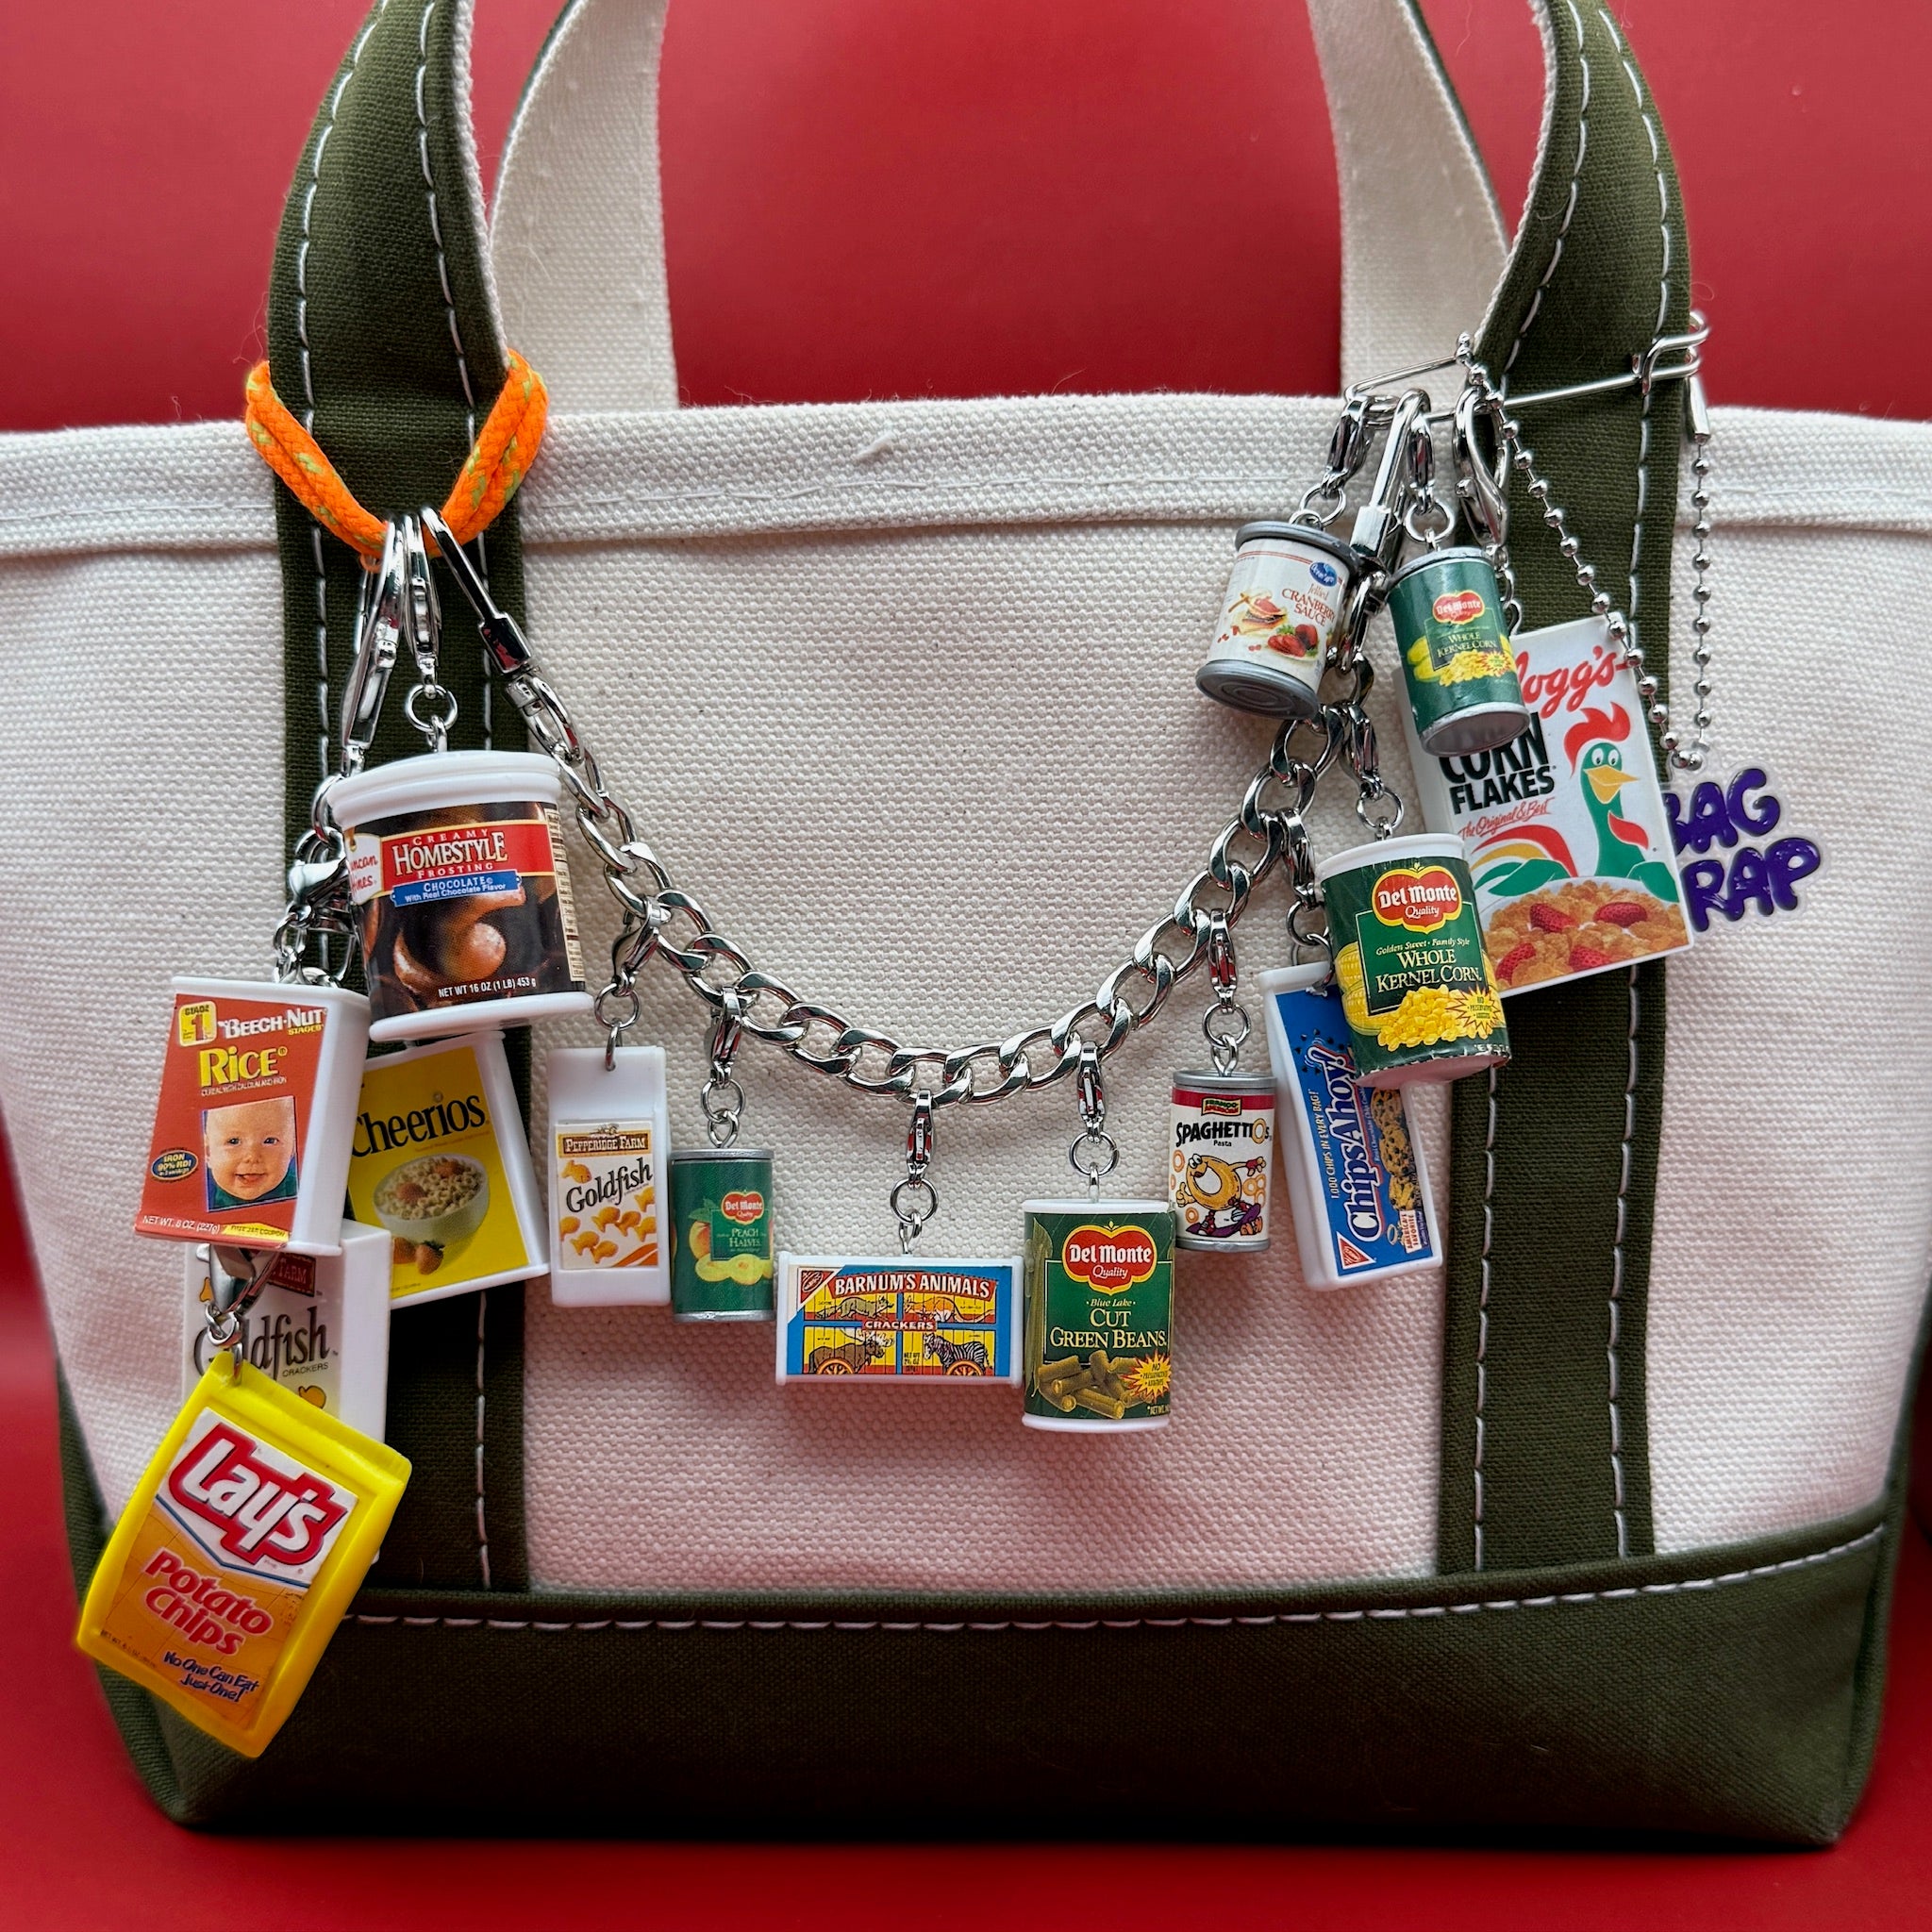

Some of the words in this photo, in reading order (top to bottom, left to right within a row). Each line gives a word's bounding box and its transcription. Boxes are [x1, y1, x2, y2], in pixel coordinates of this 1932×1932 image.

[1281, 588, 1336, 623] CRANBERRY
[1293, 602, 1326, 627] SAUCE
[1448, 631, 1481, 643] WHOLE
[1437, 641, 1472, 658] KERNEL
[1449, 765, 1555, 815] FLAKES
[1458, 821, 1475, 840] The
[1475, 807, 1517, 838] Original
[1524, 797, 1555, 819] Best
[412, 828, 488, 846] CREAMY
[351, 855, 378, 871] uncan
[392, 832, 508, 876] HOMESTYLE
[417, 862, 493, 879] FROSTING
[405, 894, 422, 903] With
[441, 885, 481, 897] Chocolate
[482, 883, 507, 891] Flavor
[424, 876, 485, 892] CHOCOLATE
[1680, 838, 1822, 932] RAP
[1377, 887, 1407, 909] Del
[1407, 884, 1457, 904] Monte
[1405, 906, 1440, 919] Quality
[1375, 943, 1403, 956] Golden
[1405, 941, 1426, 950] Sweet
[1432, 938, 1455, 946] Family
[1396, 948, 1457, 969] WHOLE
[438, 987, 453, 998] NET
[454, 984, 467, 995] WT
[469, 983, 479, 993] 16
[480, 981, 491, 991] OZ
[493, 981, 501, 991] (1
[503, 978, 515, 990] LB)
[517, 976, 530, 988] 453
[531, 977, 537, 988] g
[1375, 968, 1440, 992] KERNEL
[192, 1014, 203, 1041] 1
[1316, 1114, 1327, 1139] EVERY
[566, 1138, 618, 1153] PEPPERIDGE
[619, 1135, 646, 1149] FARM
[1321, 1138, 1330, 1151] IN
[1323, 1152, 1336, 1177] CHIPS
[566, 1157, 653, 1213] Goldfish
[724, 1201, 739, 1210] Del
[142, 1215, 159, 1224] NET
[731, 1228, 758, 1237] PEACH
[1069, 1243, 1097, 1263] Del
[1098, 1244, 1152, 1263] Monte
[1092, 1264, 1129, 1279] Quality
[835, 1274, 916, 1296] BARNUM'S
[919, 1274, 990, 1299] ANIMALS
[1090, 1298, 1111, 1307] Blue
[1112, 1298, 1132, 1307] Lake
[865, 1321, 934, 1330] CRACKERS
[1090, 1307, 1132, 1327] CUT
[1050, 1326, 1109, 1349] GREEN
[283, 1362, 329, 1377] CRACKERS
[182, 1438, 328, 1552] Lay's
[142, 1548, 275, 1637] Potato
[144, 1586, 246, 1657] Chips
[163, 1651, 182, 1667] No
[182, 1658, 208, 1675] One
[208, 1665, 233, 1684] Can
[233, 1674, 261, 1692] Eat
[180, 1673, 210, 1690] Just
[208, 1682, 248, 1703] One!
